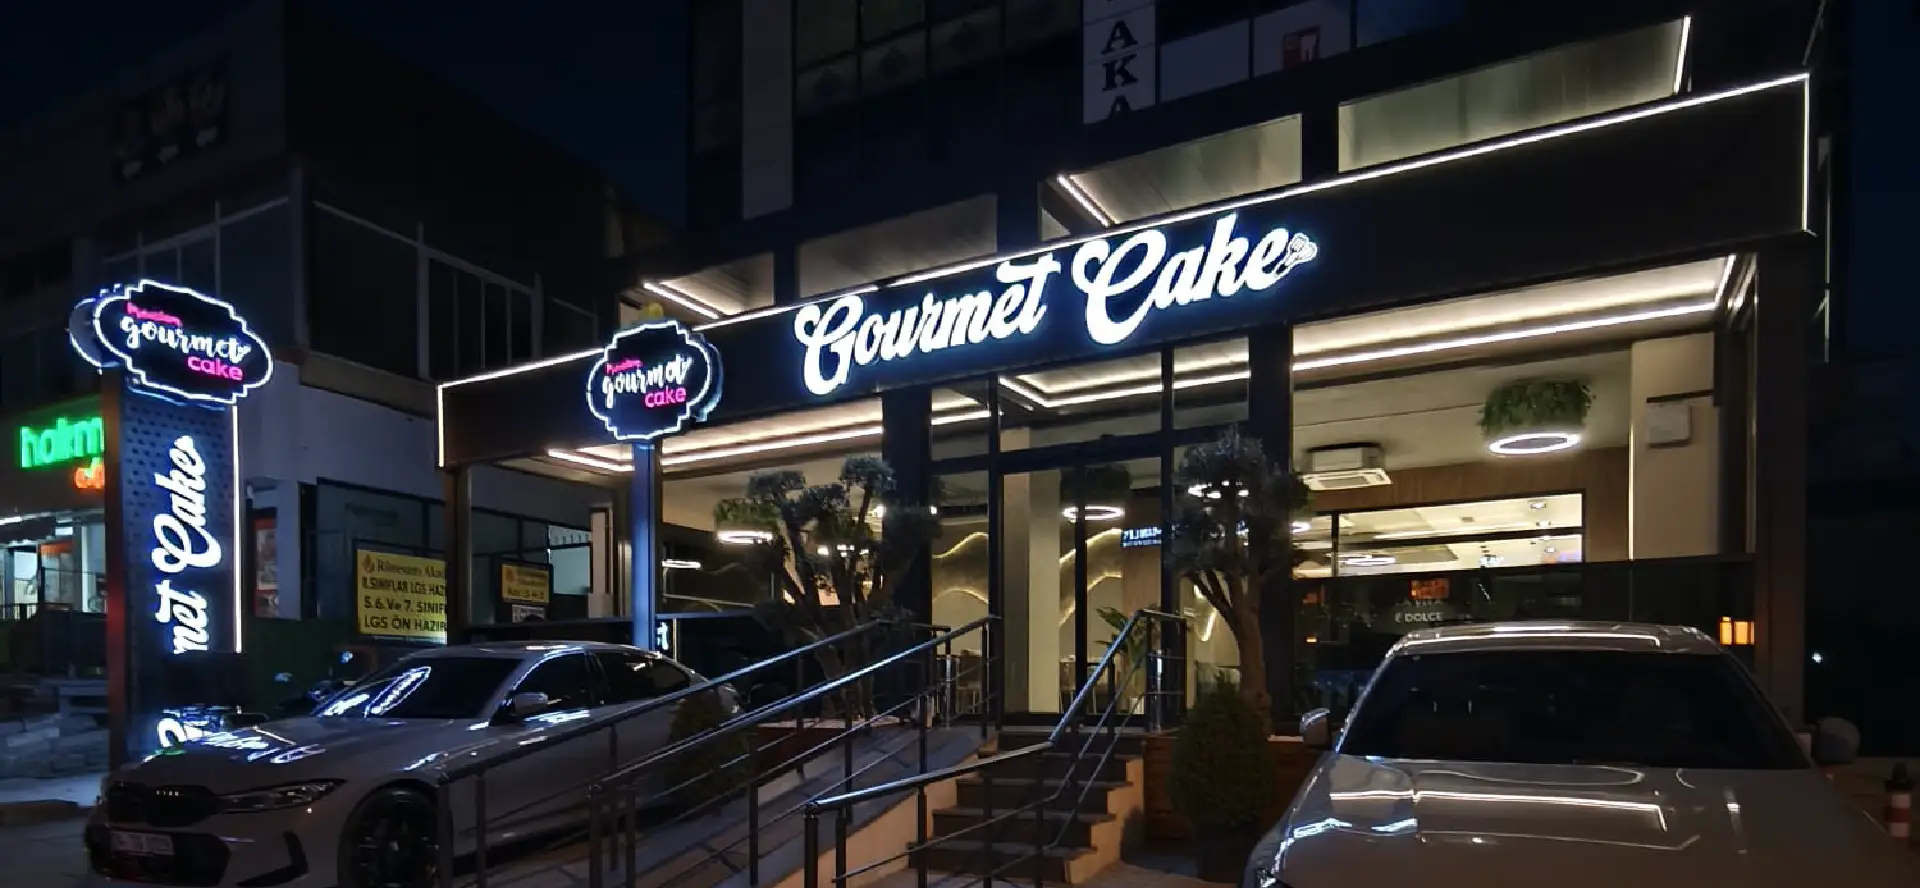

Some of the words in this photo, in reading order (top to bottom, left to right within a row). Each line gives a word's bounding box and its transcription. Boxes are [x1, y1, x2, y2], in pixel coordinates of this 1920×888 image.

[1101, 0, 1139, 119] AKA
[120, 315, 252, 363] gourmet
[794, 253, 1061, 395] Gourmet
[1071, 212, 1290, 345] Cake
[187, 356, 244, 381] cake
[644, 386, 687, 407] cake
[151, 446, 222, 573] Cake
